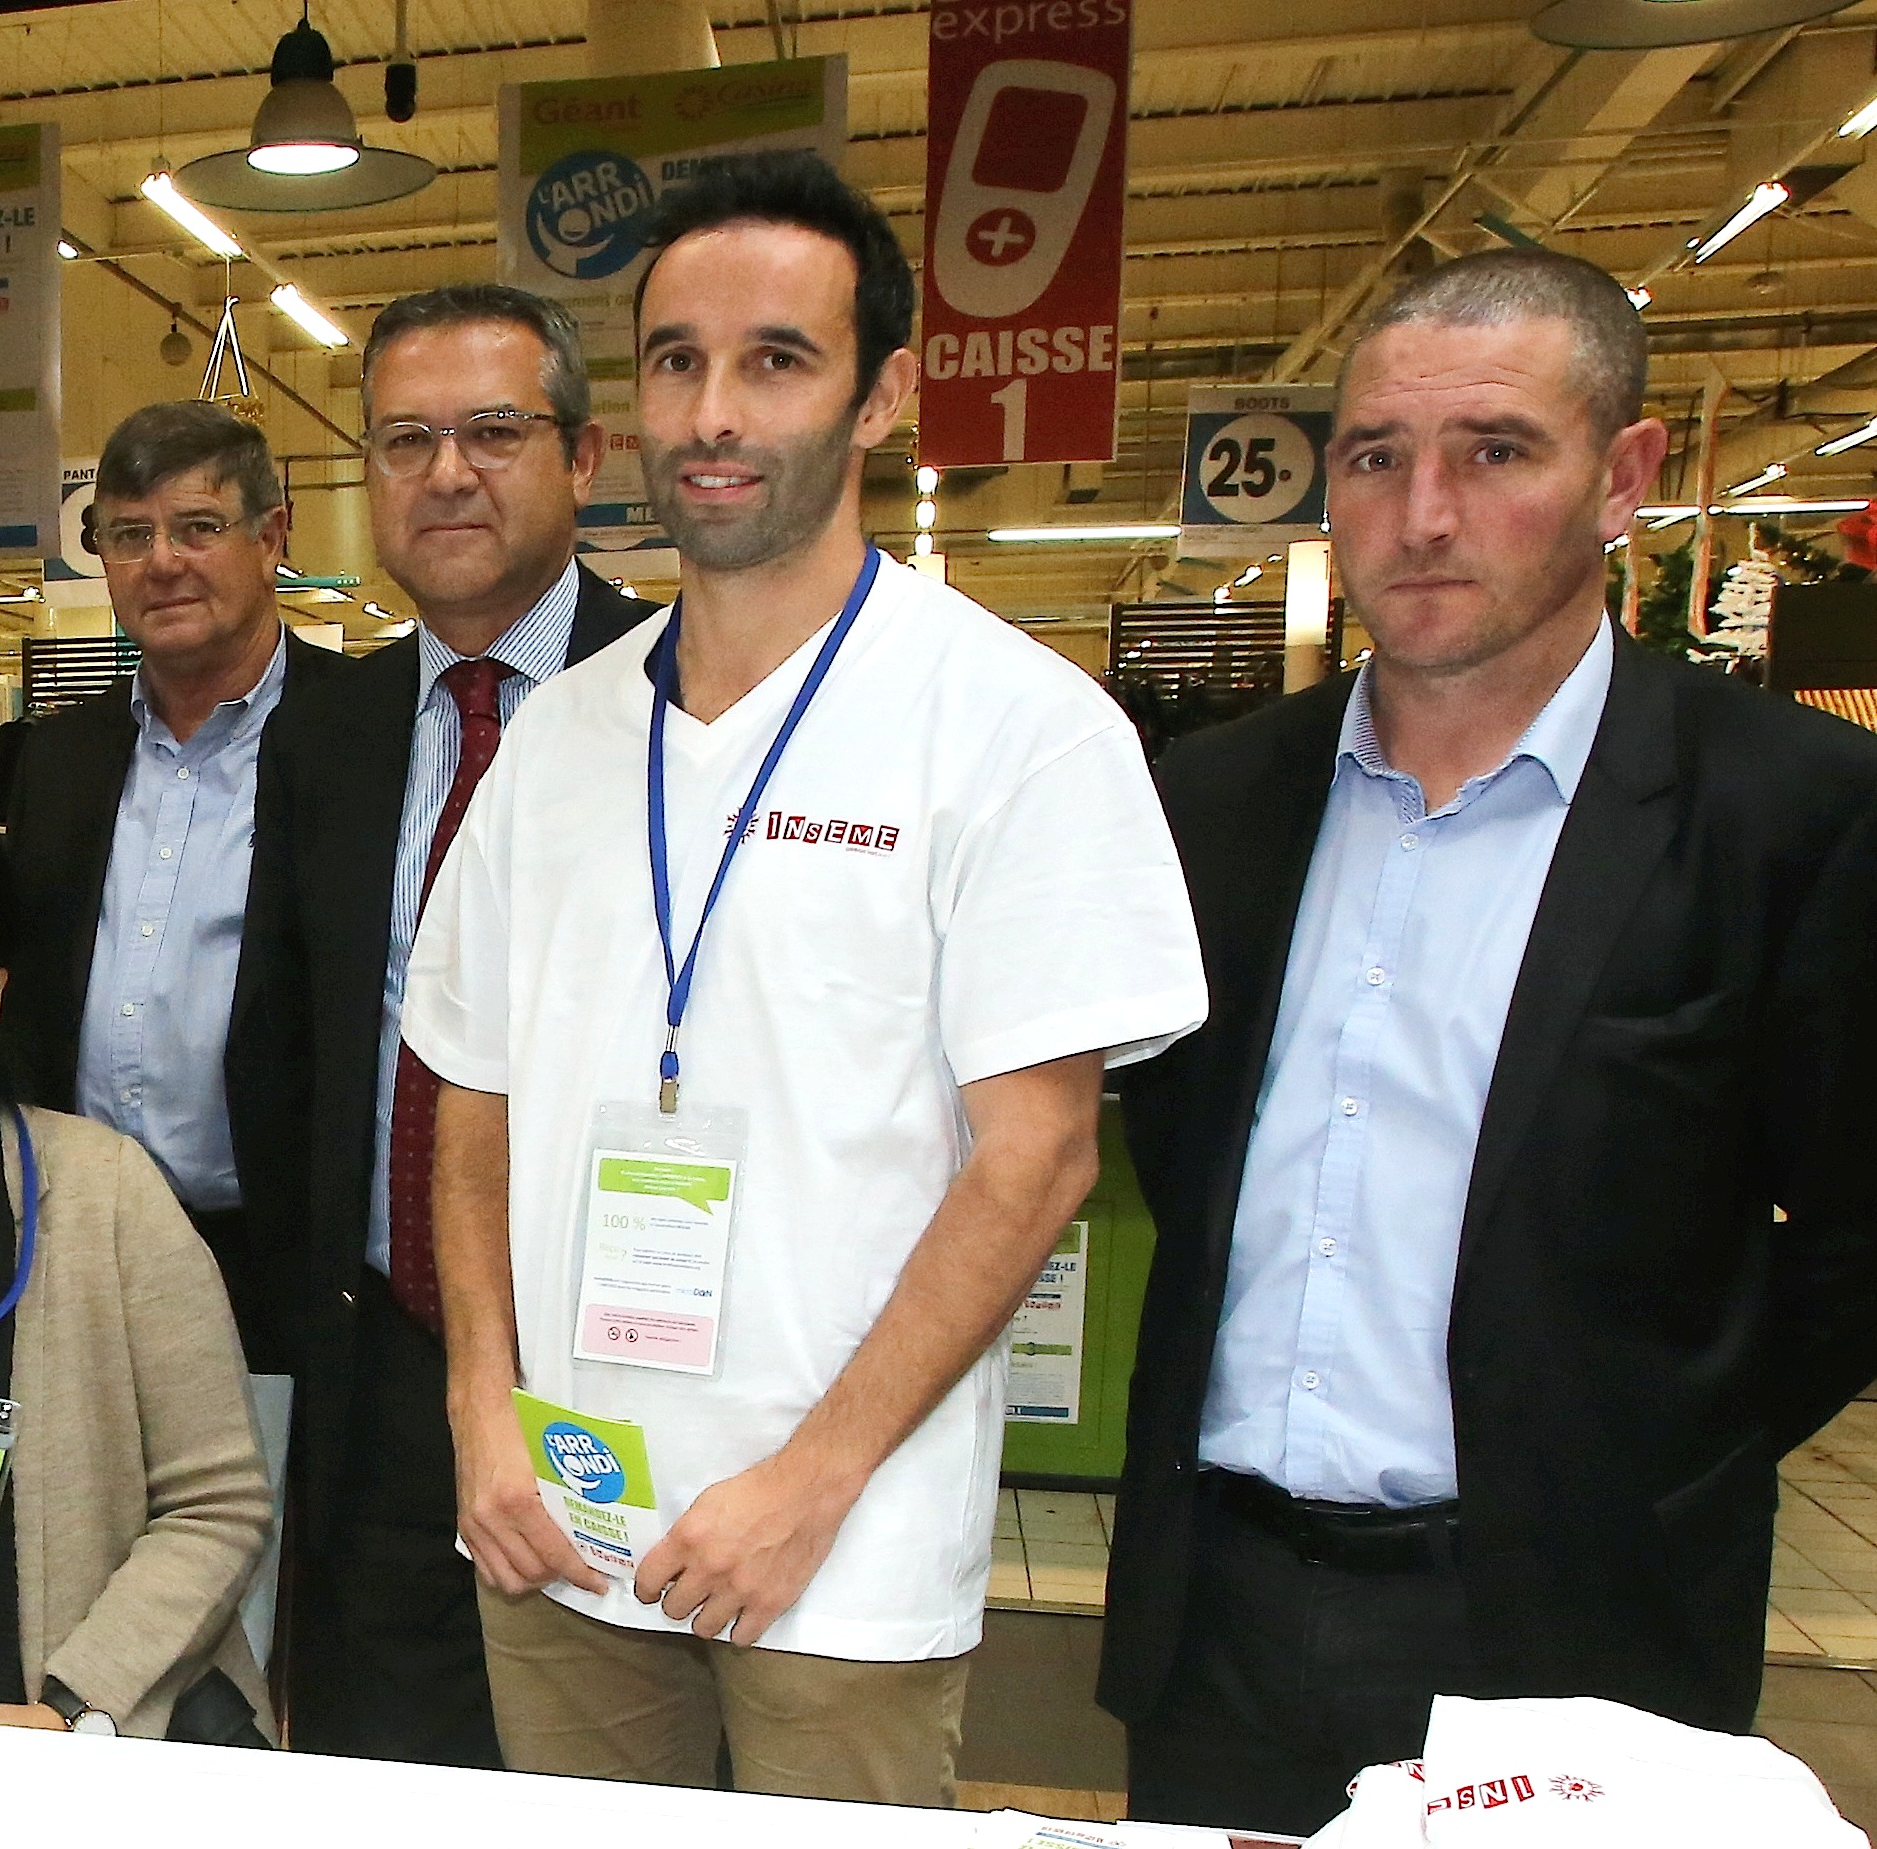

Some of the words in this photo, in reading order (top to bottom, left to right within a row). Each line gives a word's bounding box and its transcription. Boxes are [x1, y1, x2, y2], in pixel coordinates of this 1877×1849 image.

[932, 0, 1125, 44] express
[924, 324, 1116, 380] CAISSE
[990, 380, 1028, 462] 1
[1234, 397, 1291, 410] BOOTS
[64, 468, 97, 481] PANT
[1207, 438, 1276, 498] 25
[766, 811, 900, 852] INSEME
[602, 1213, 629, 1230] 100
[633, 1215, 646, 1231] %
[544, 1433, 597, 1455] L'ARR
